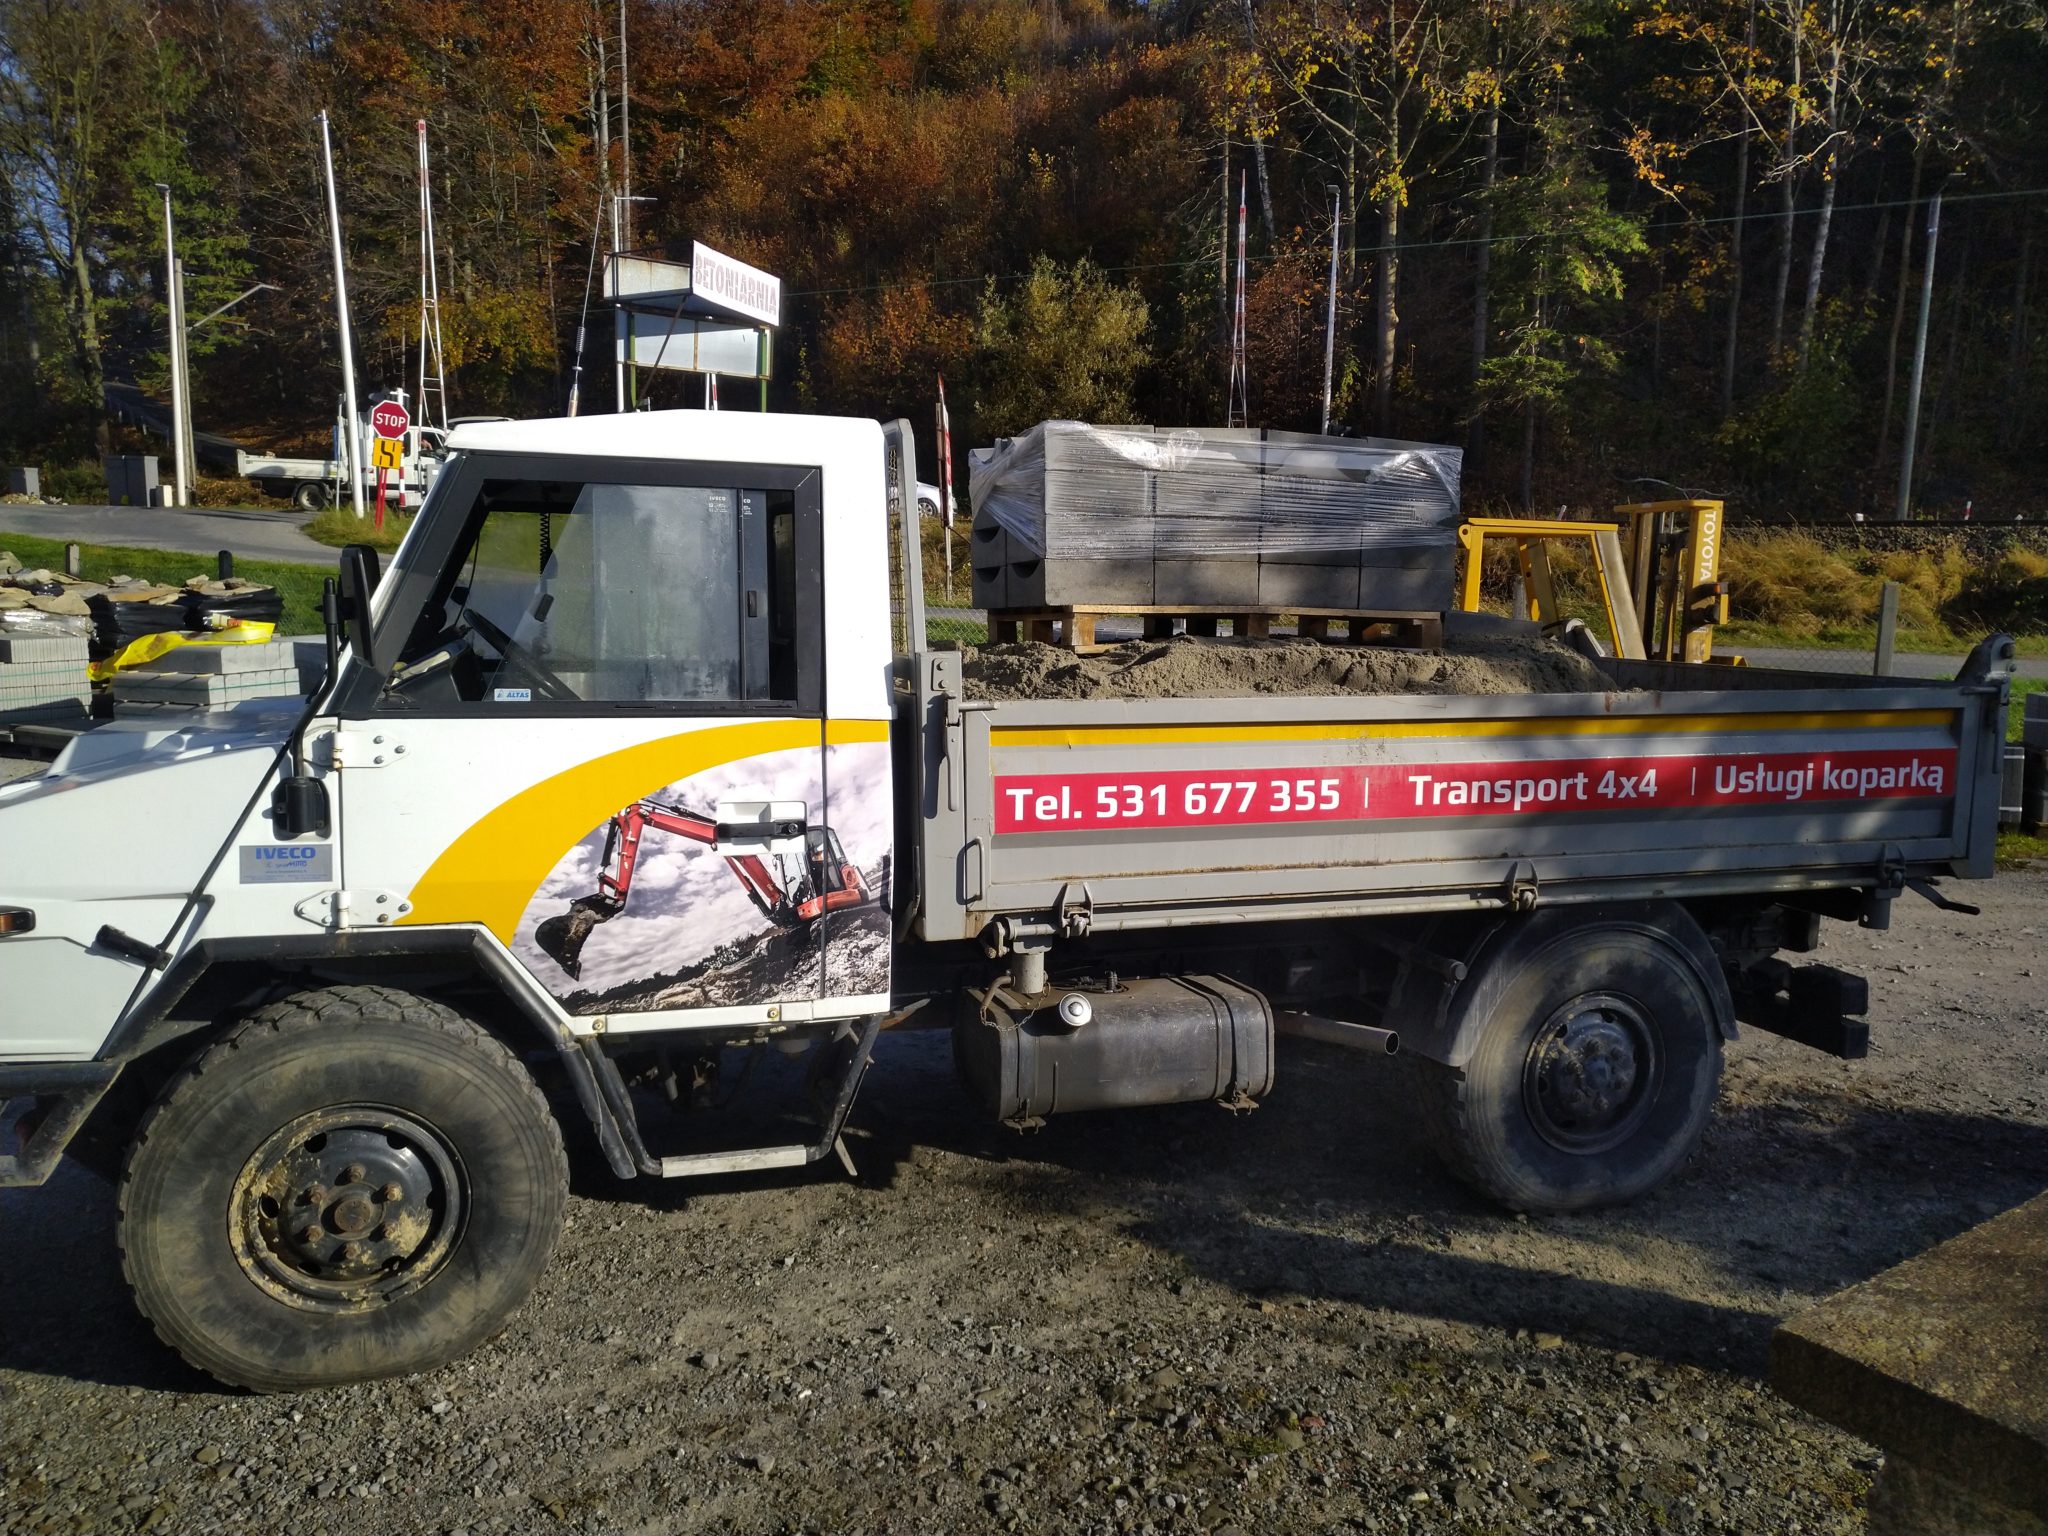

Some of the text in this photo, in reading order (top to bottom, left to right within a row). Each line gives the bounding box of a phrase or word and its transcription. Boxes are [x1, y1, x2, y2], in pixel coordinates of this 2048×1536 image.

[694, 252, 777, 315] BETONIARNIA
[376, 412, 406, 428] STOP
[1699, 511, 1717, 581] TOYOTA
[1005, 758, 1945, 821] Tel. 531 677 355 Transport 4x4 Usługi koparką
[255, 847, 316, 860] IVECO
